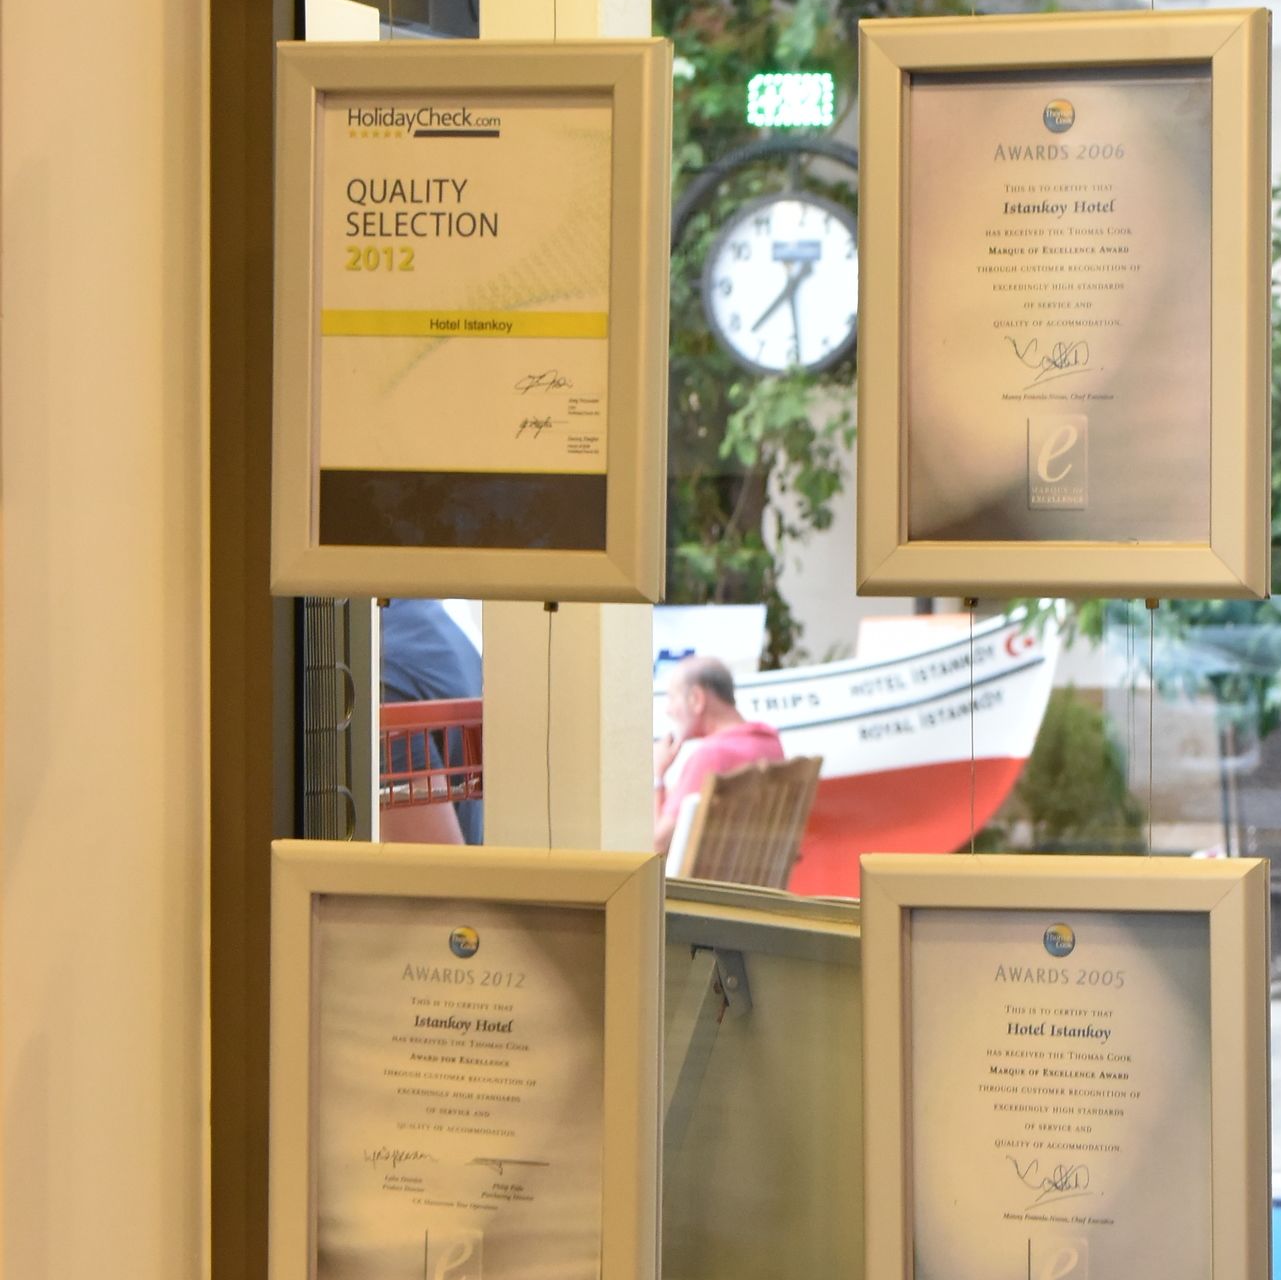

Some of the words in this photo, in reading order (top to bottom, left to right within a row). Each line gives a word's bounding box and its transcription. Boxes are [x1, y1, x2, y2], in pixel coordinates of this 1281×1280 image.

[1076, 143, 1125, 159] 2006
[346, 178, 468, 205] QUALITY
[1003, 201, 1068, 219] Istankoy
[1074, 199, 1116, 213] Hotel
[346, 212, 498, 237] SELECTION
[345, 245, 415, 271] 2012
[430, 319, 460, 330] Hotel
[464, 319, 512, 334] Istankoy
[851, 674, 906, 696] HOTEL
[480, 971, 526, 988] 2012
[1076, 969, 1125, 989] 2005
[414, 1015, 471, 1035] Istankoy
[475, 1019, 513, 1033] Hotel
[1007, 1022, 1045, 1036] Hotel
[1050, 1024, 1111, 1045] Istankoy
